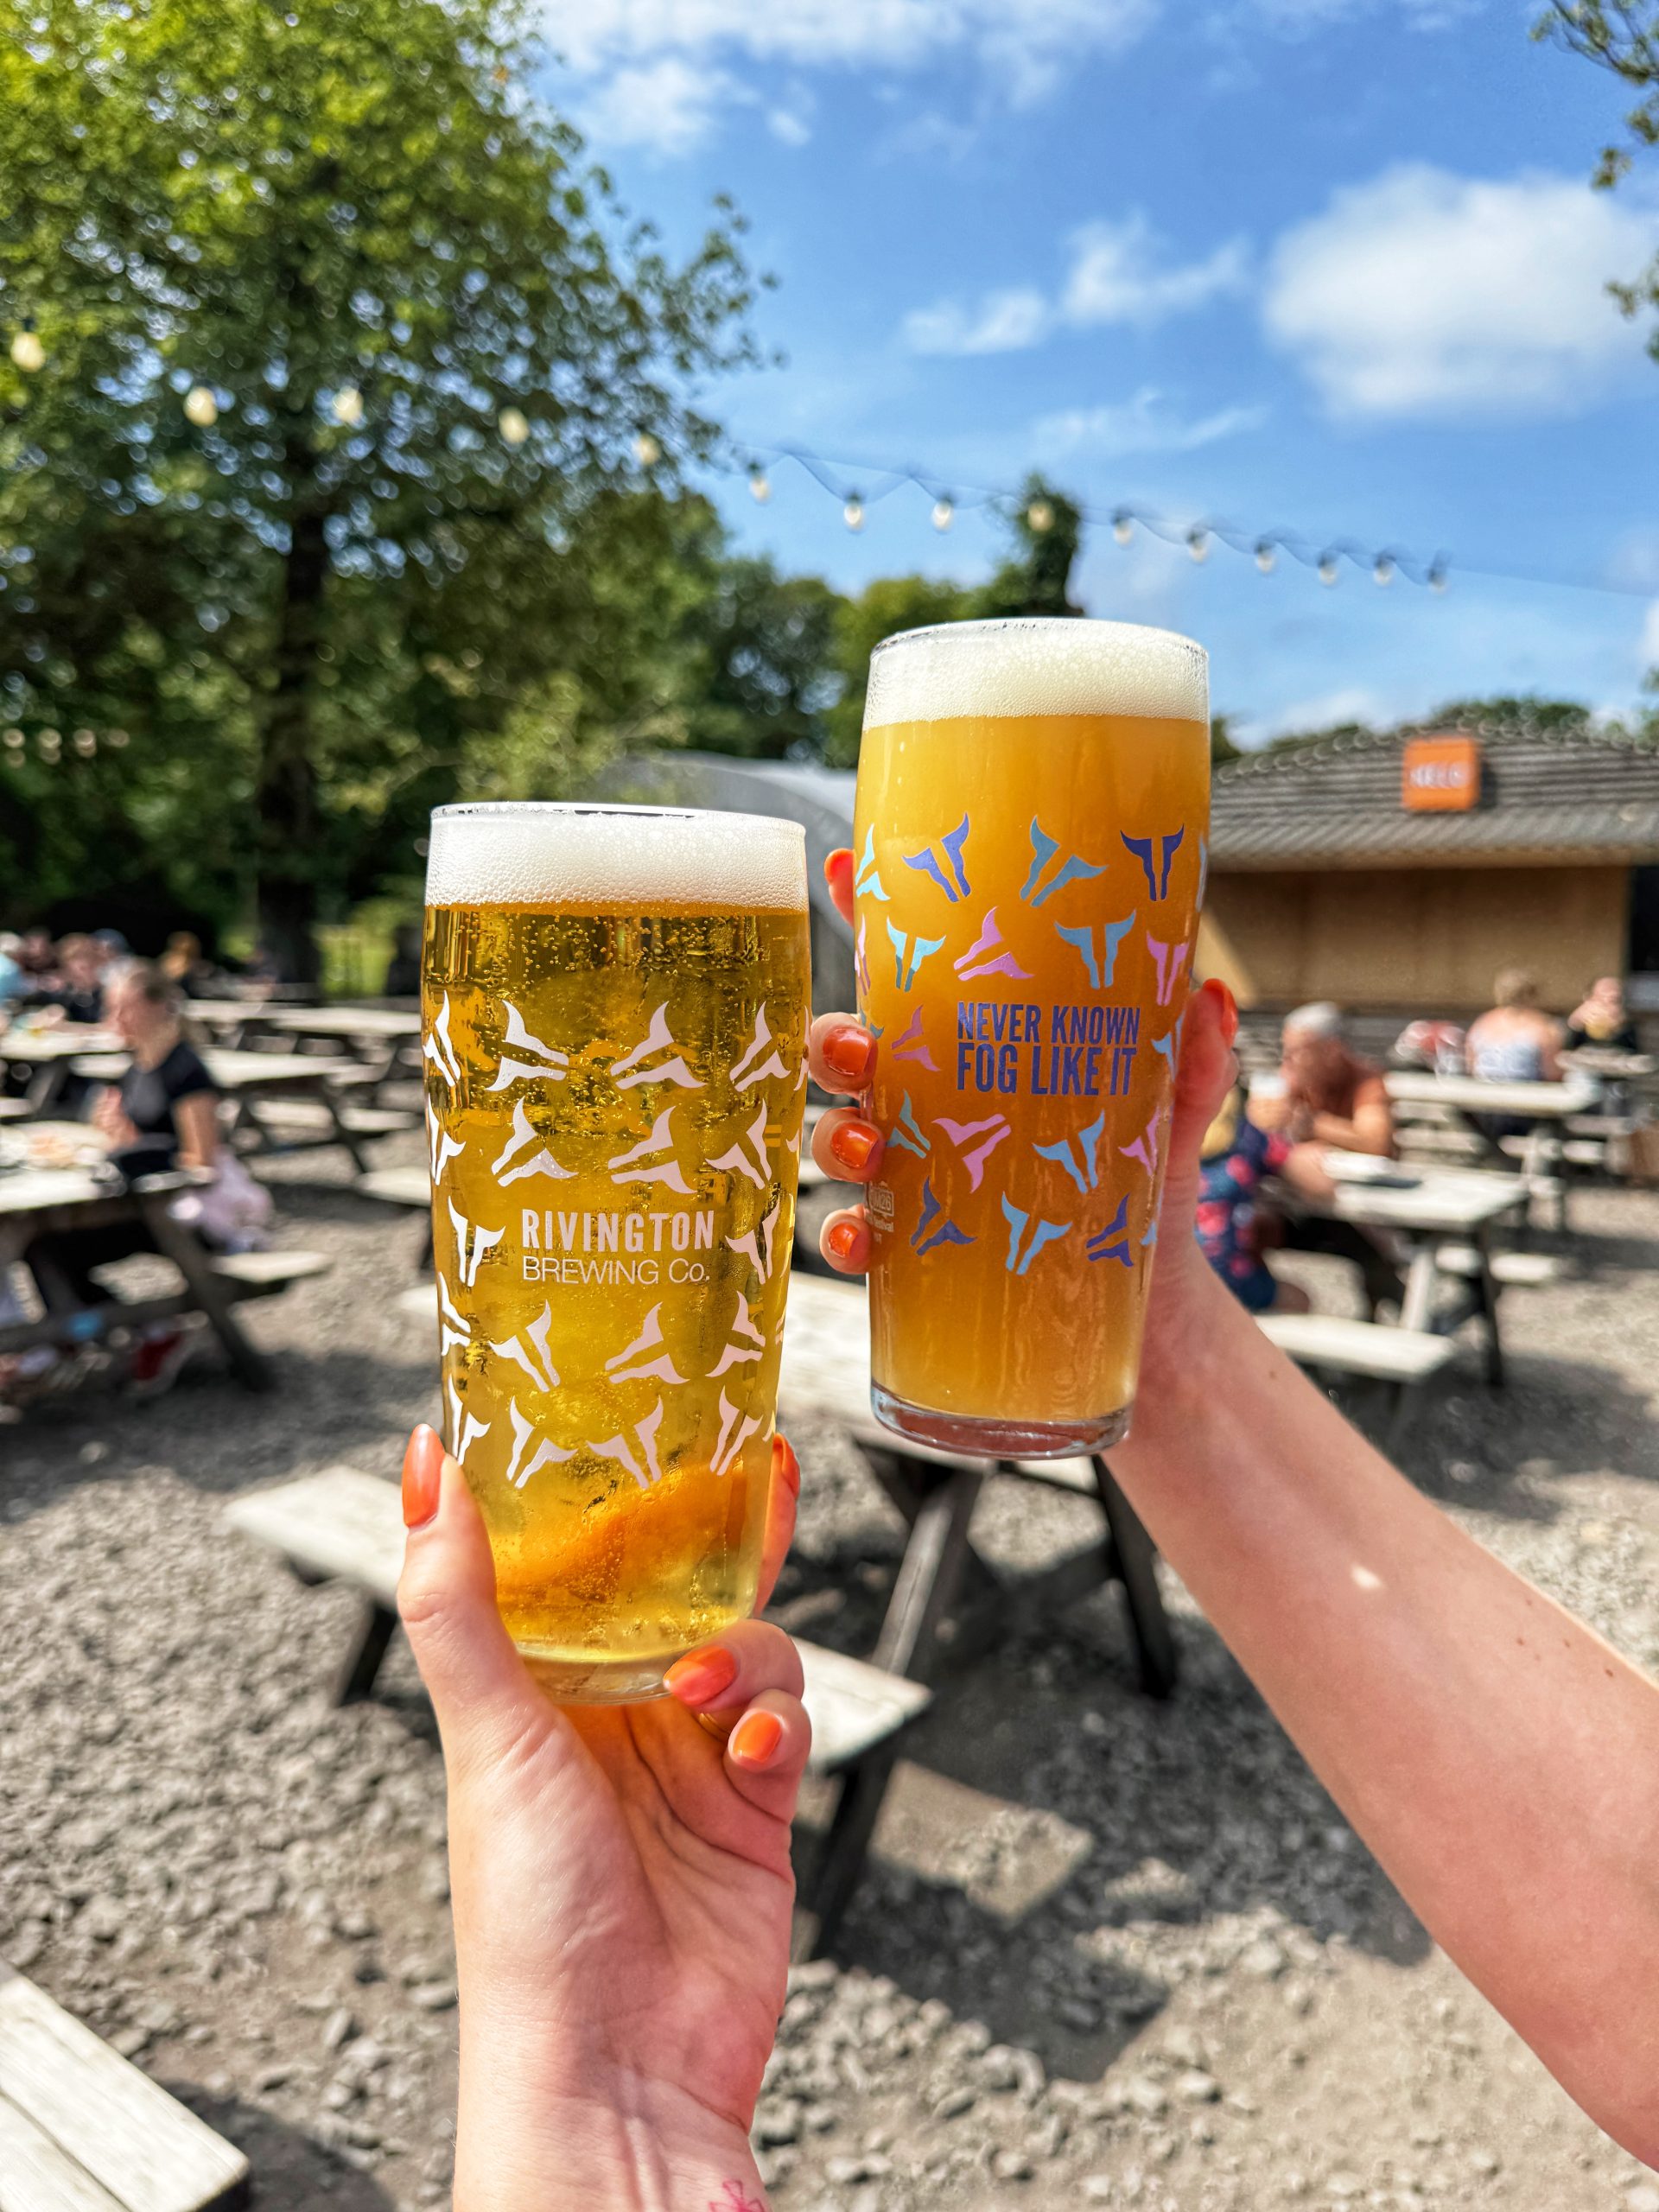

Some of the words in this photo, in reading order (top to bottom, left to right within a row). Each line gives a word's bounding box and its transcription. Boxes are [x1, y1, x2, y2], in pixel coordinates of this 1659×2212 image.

[957, 1001, 1042, 1043] NEVER
[1051, 1005, 1141, 1046] KNOWN
[957, 1042, 1018, 1094] FOG
[1030, 1046, 1102, 1096] LIKE
[1109, 1047, 1137, 1096] IT
[522, 1209, 715, 1252] RIVINGTON
[523, 1255, 658, 1285] BREWING
[669, 1257, 710, 1282] Co.
